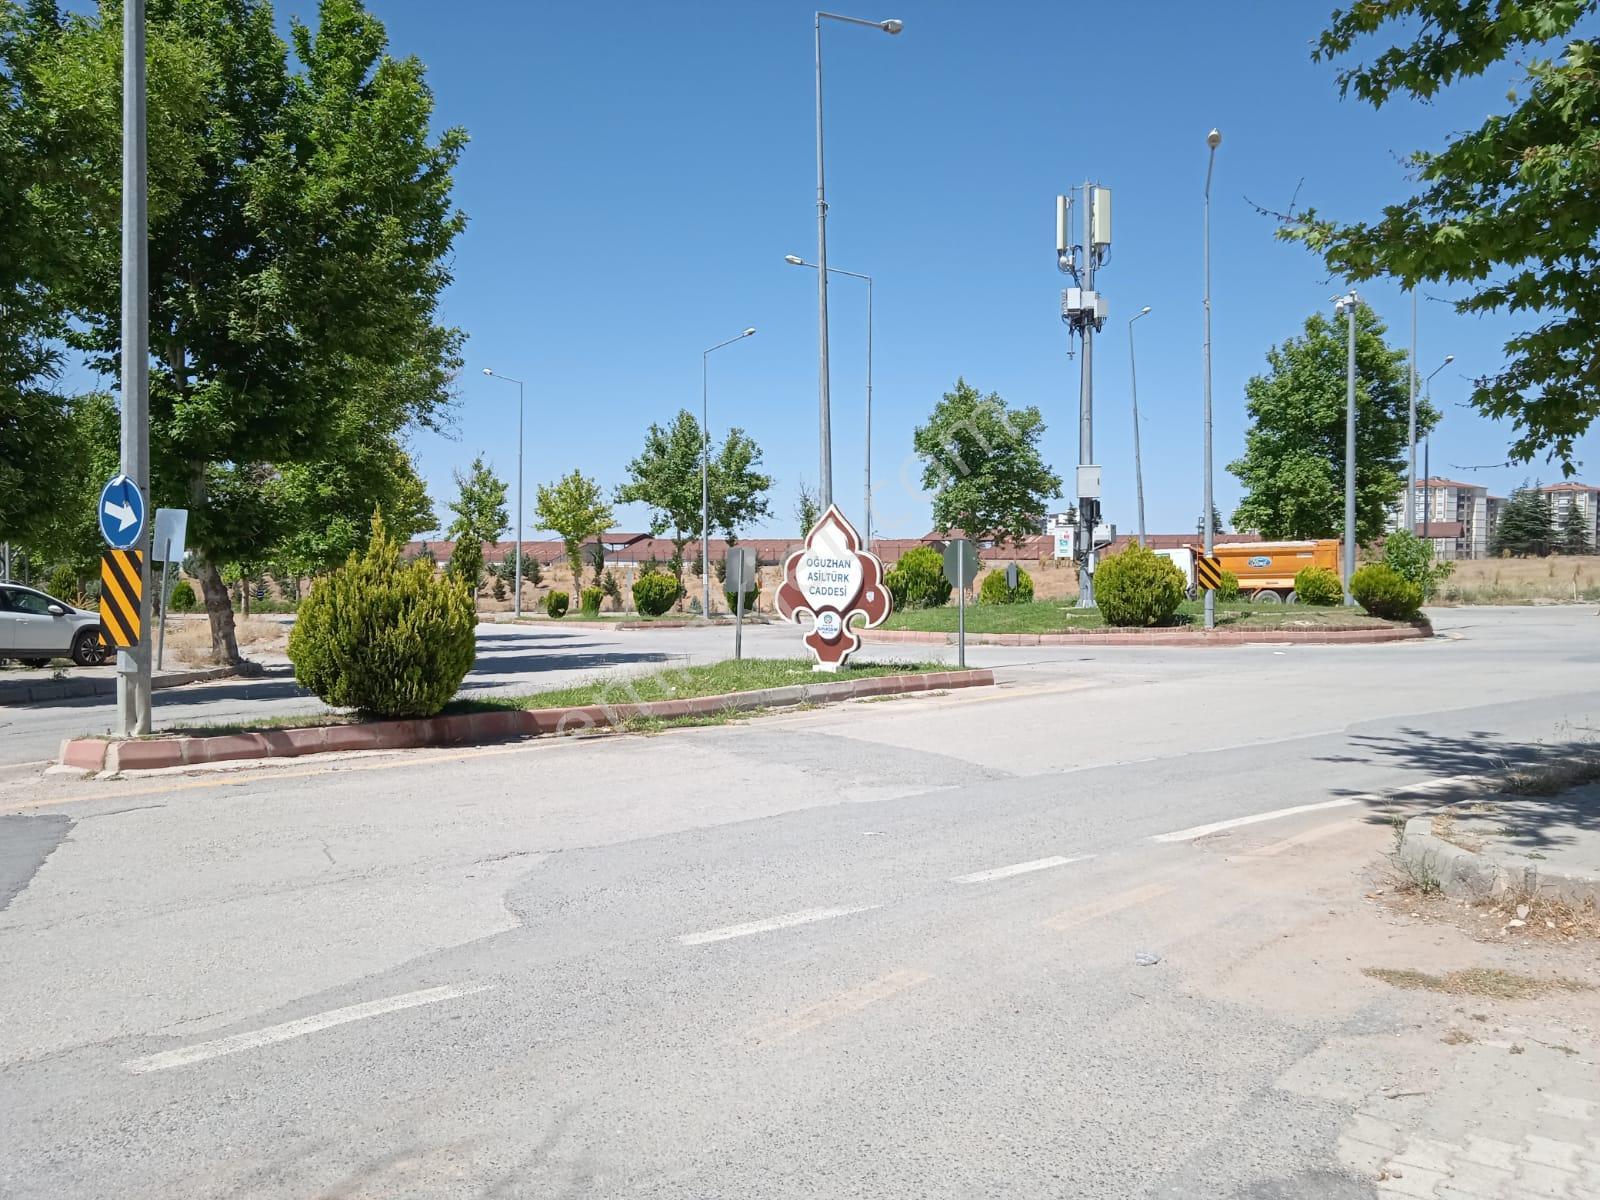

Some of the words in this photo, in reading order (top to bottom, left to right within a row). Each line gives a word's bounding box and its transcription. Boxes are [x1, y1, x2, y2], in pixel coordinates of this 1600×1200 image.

[806, 556, 851, 568] OĞUZHAN
[807, 570, 849, 582] ASİLTÜRK
[808, 585, 847, 597] CADDESİ
